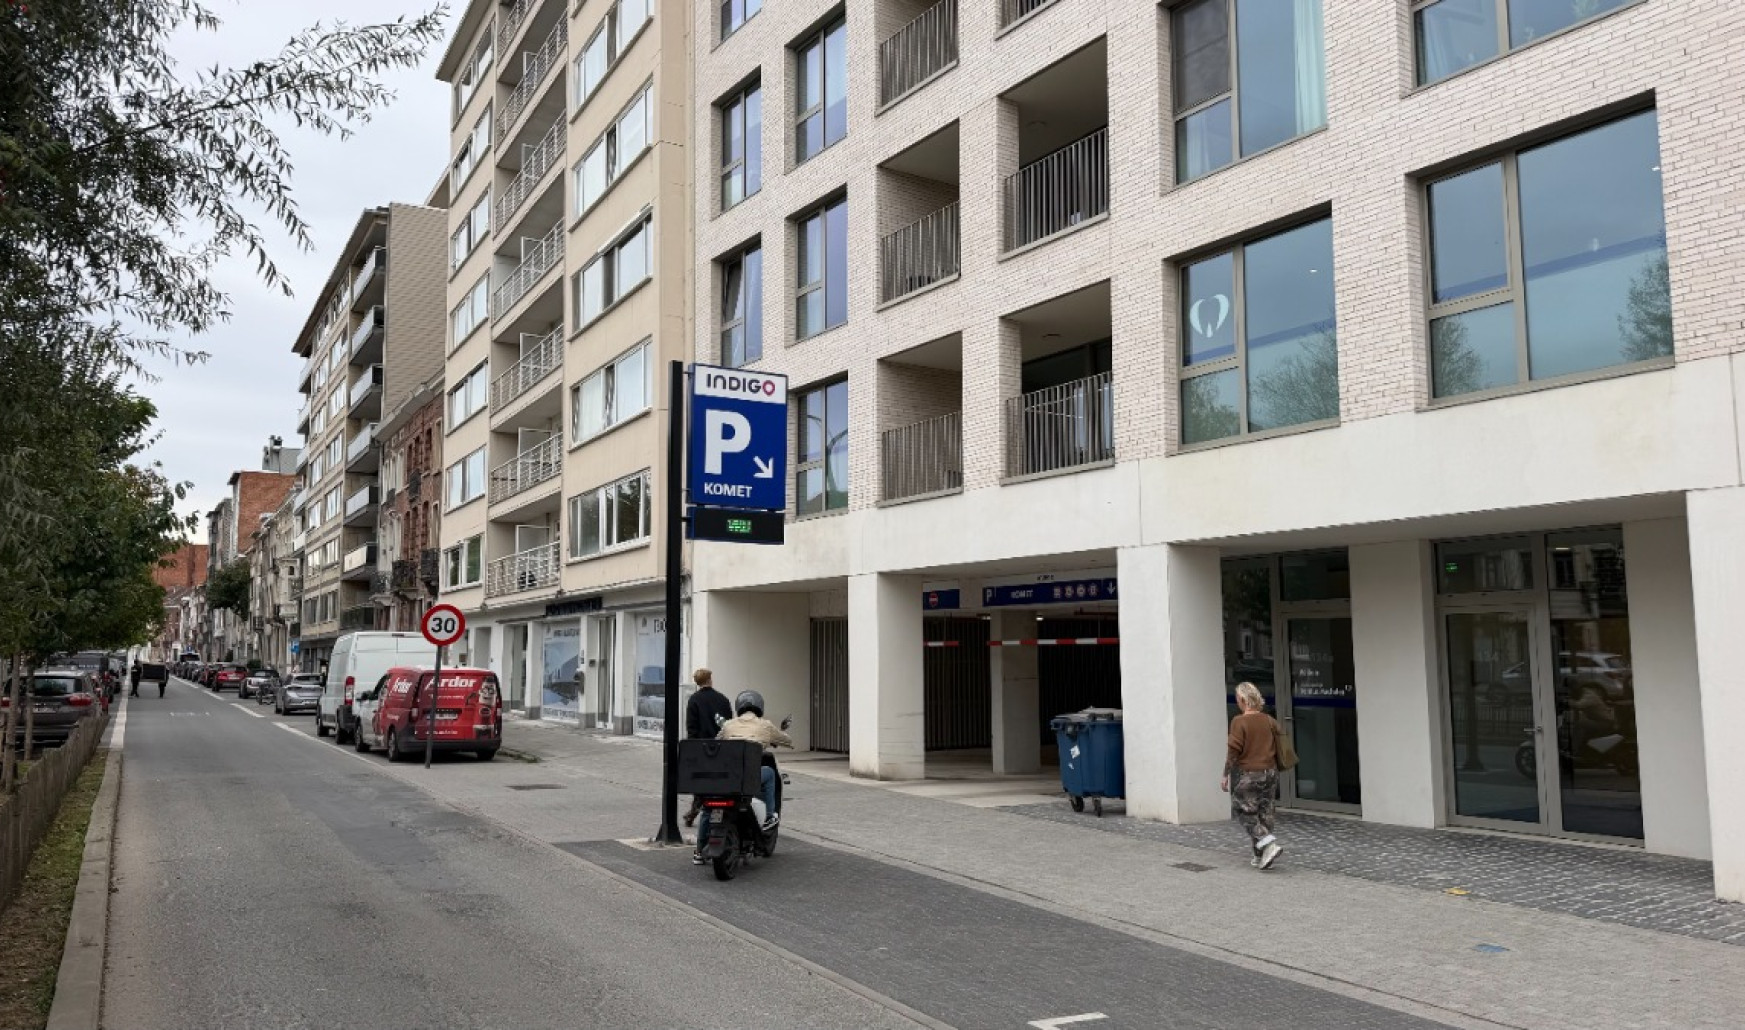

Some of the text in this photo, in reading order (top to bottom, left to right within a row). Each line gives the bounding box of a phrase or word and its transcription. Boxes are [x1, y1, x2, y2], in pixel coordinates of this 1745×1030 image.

[706, 373, 776, 397] INDIGO
[704, 408, 752, 475] P
[703, 482, 753, 499] KOMET
[431, 617, 456, 633] 30
